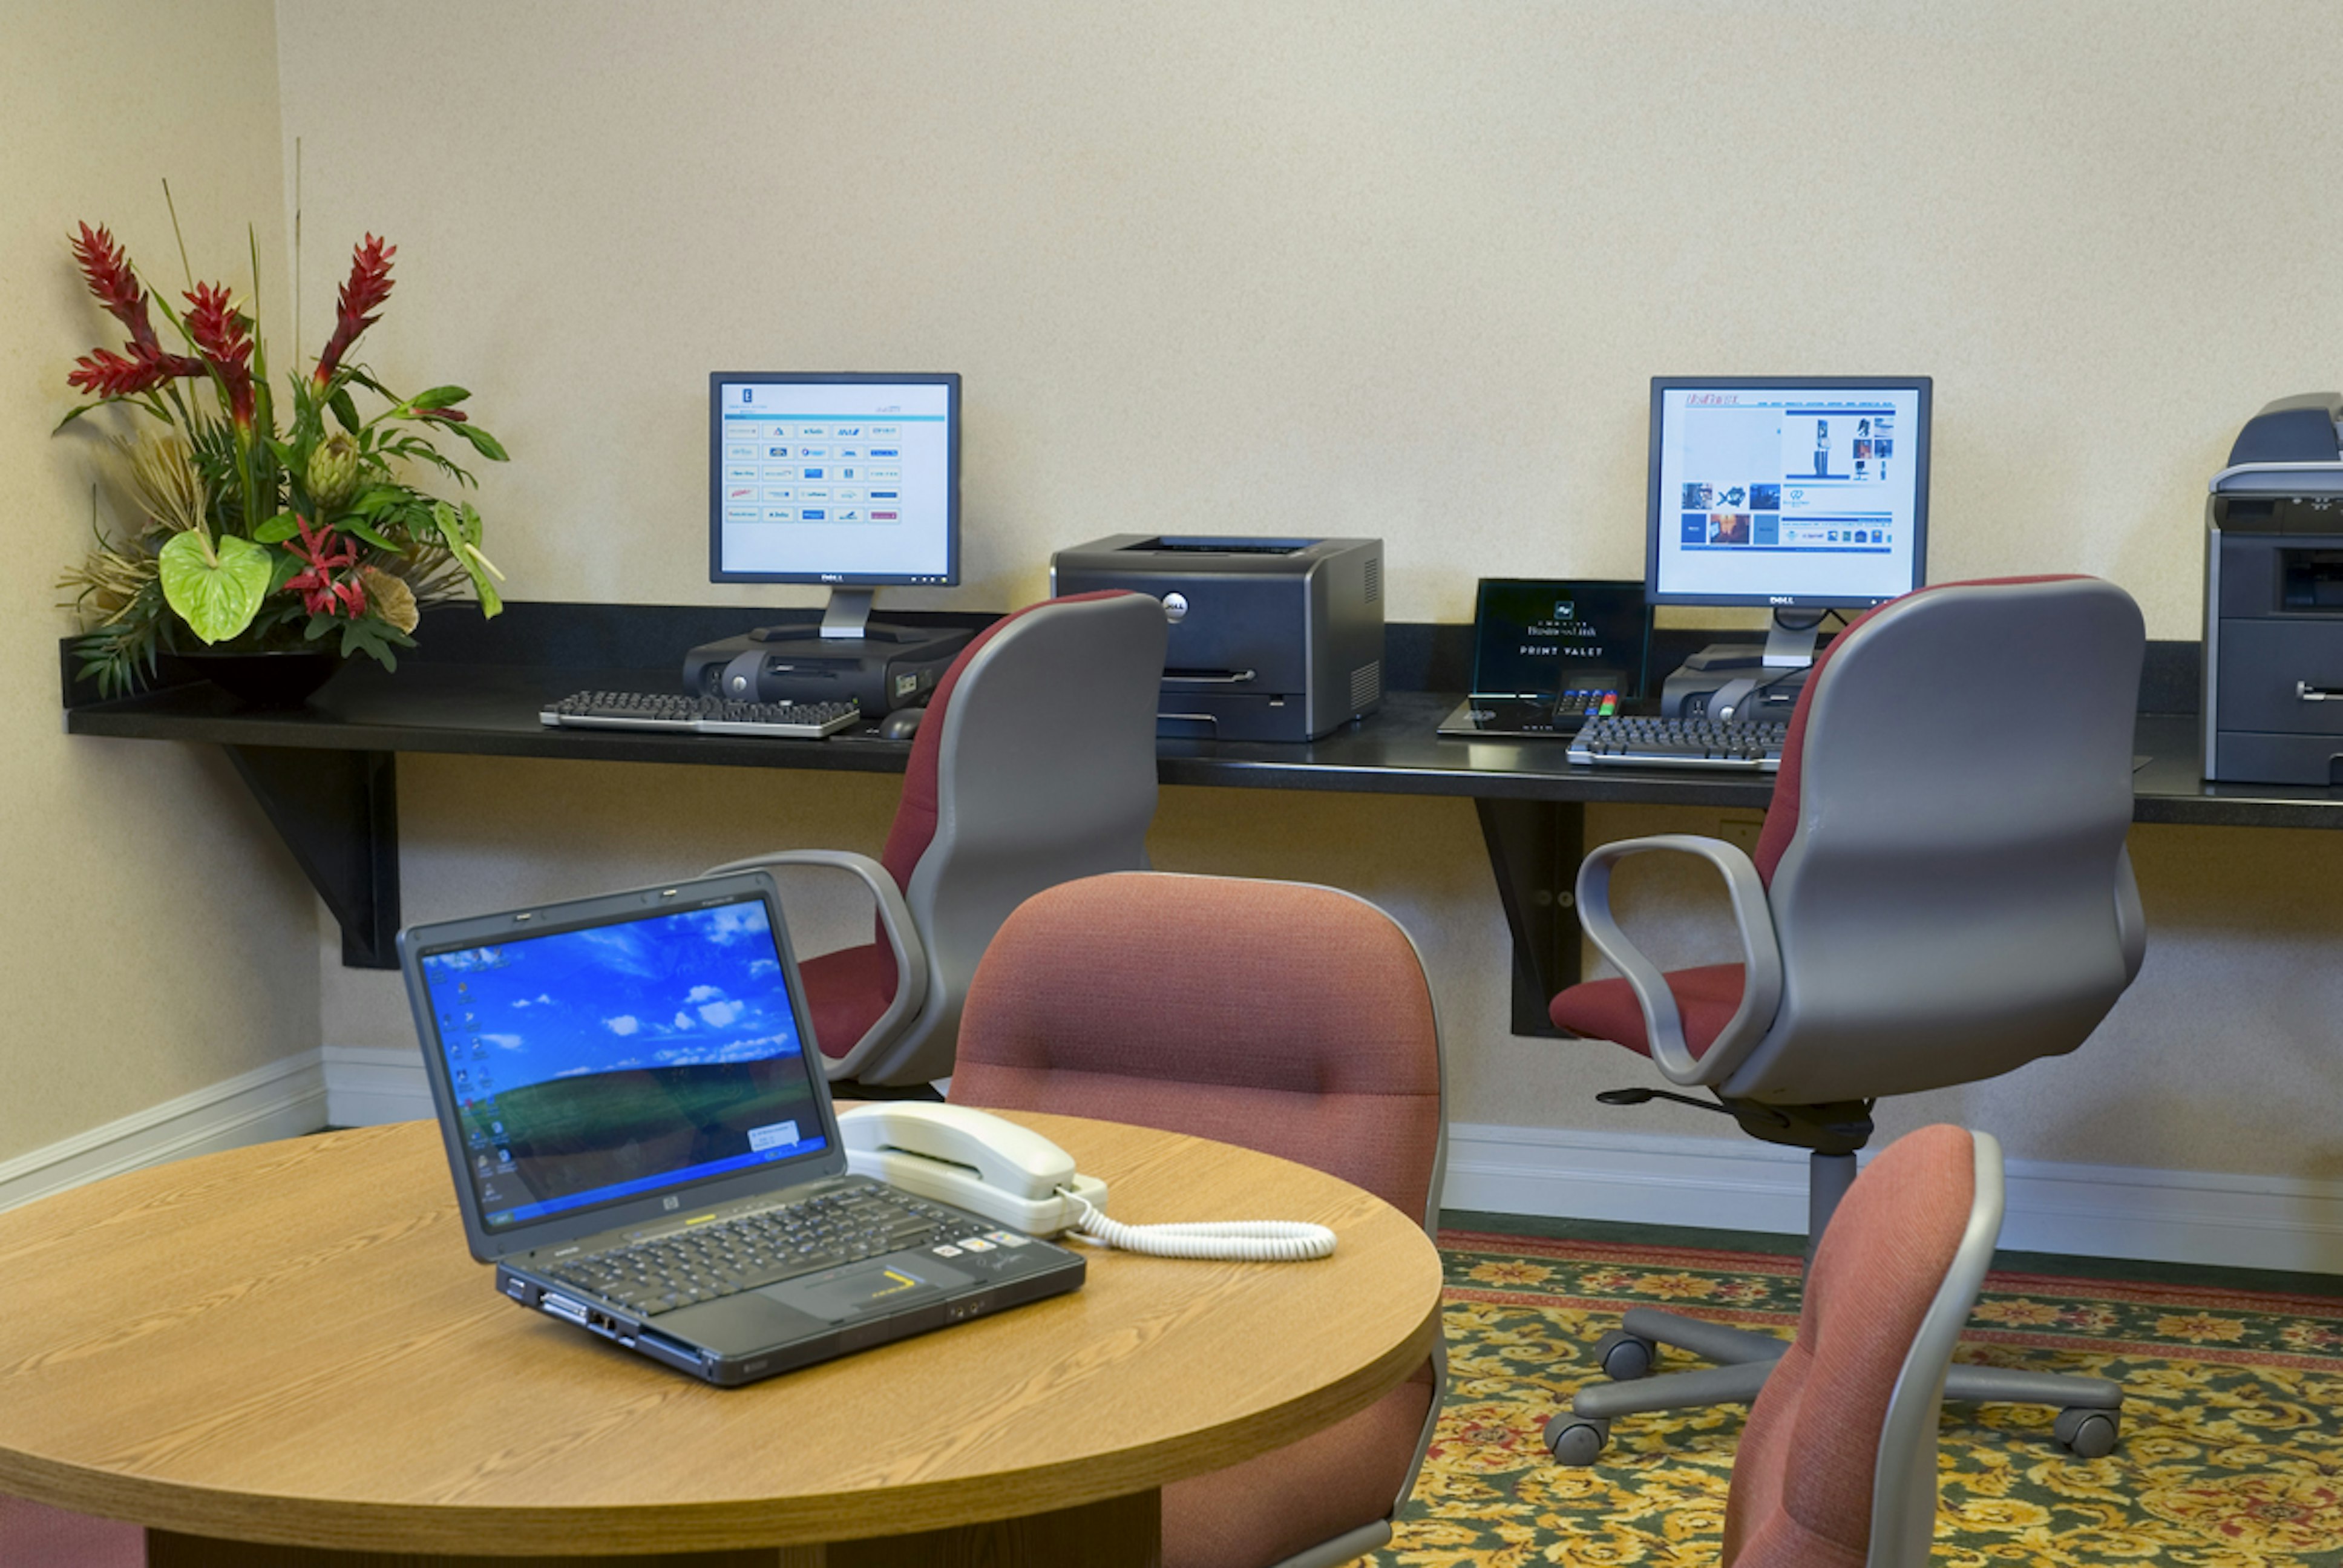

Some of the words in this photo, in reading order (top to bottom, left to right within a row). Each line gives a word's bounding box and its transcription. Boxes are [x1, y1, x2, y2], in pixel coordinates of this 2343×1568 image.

[1770, 596, 1794, 605] DELL
[1519, 645, 1558, 656] PRINT
[1563, 647, 1603, 657] VALET
